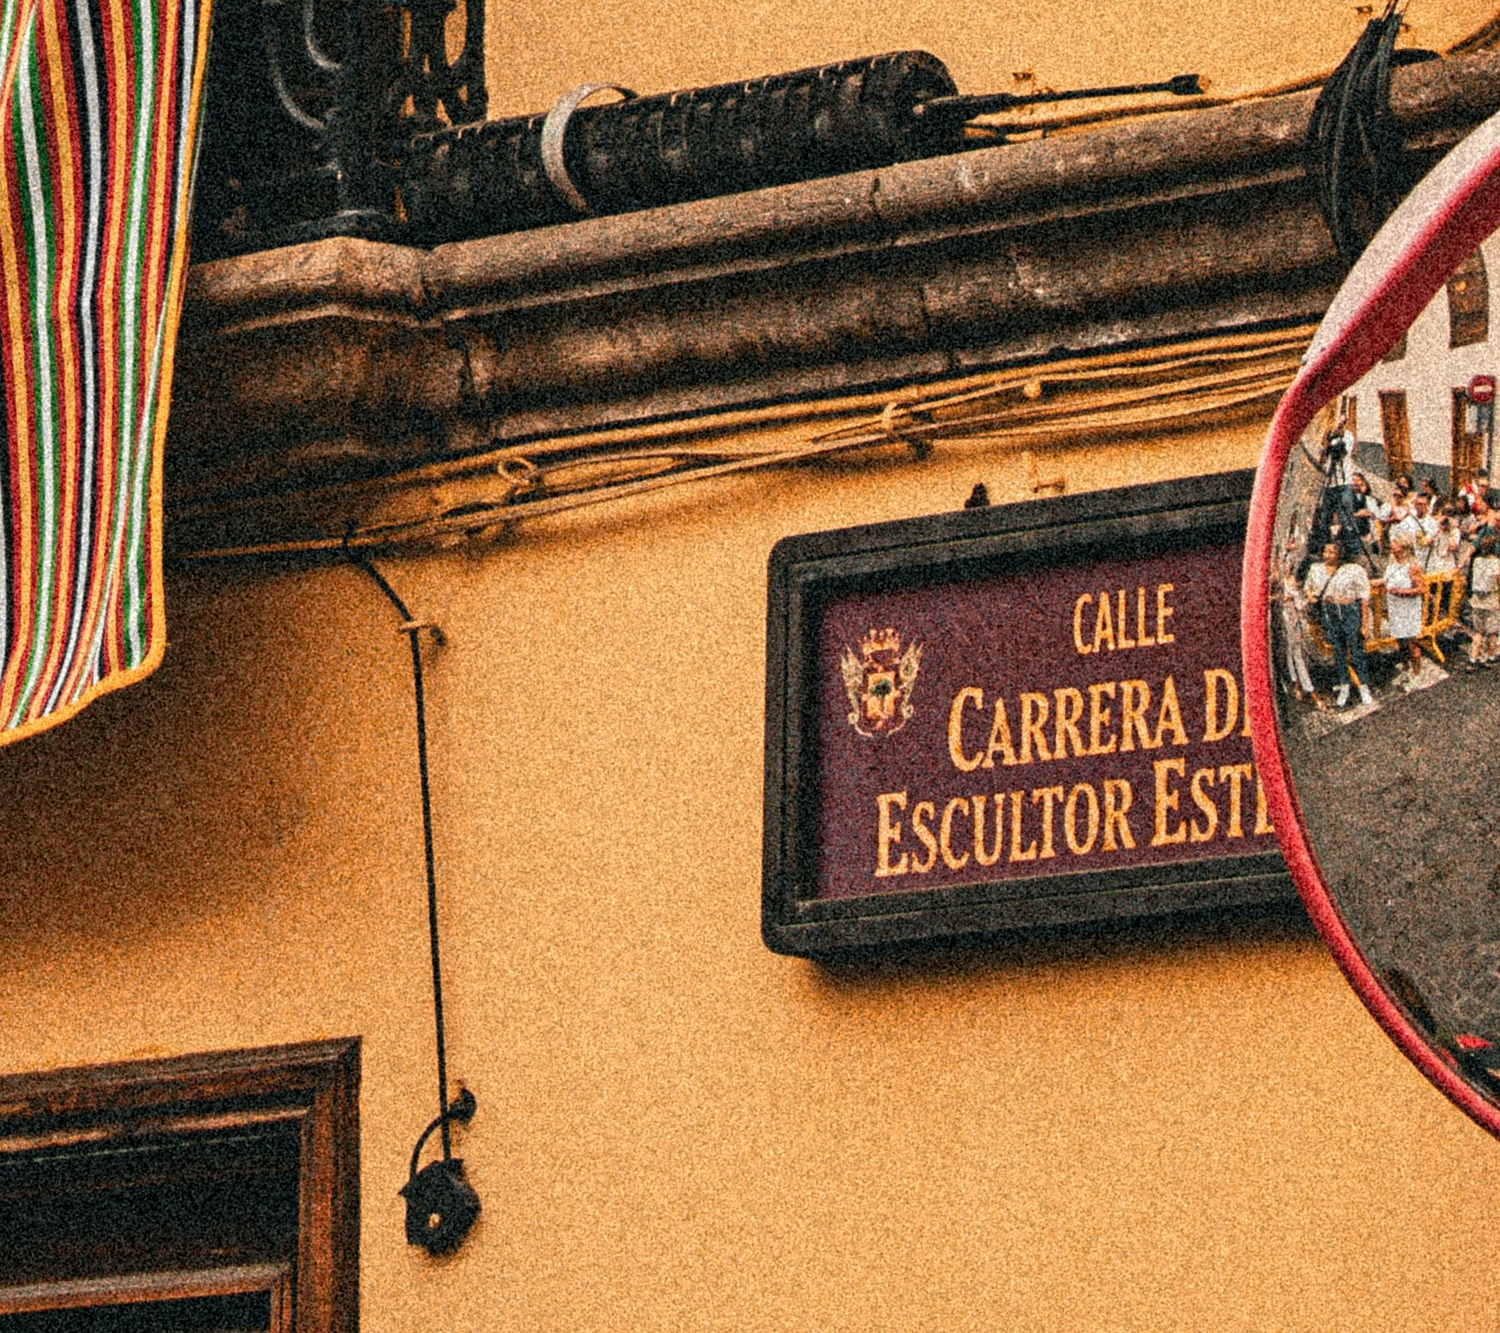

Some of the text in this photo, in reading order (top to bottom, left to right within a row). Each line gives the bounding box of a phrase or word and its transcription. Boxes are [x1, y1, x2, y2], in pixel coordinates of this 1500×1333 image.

[1073, 583, 1174, 656] CALLE
[947, 668, 1252, 772] CARRERA D
[873, 777, 1136, 878] ESCULTOR
